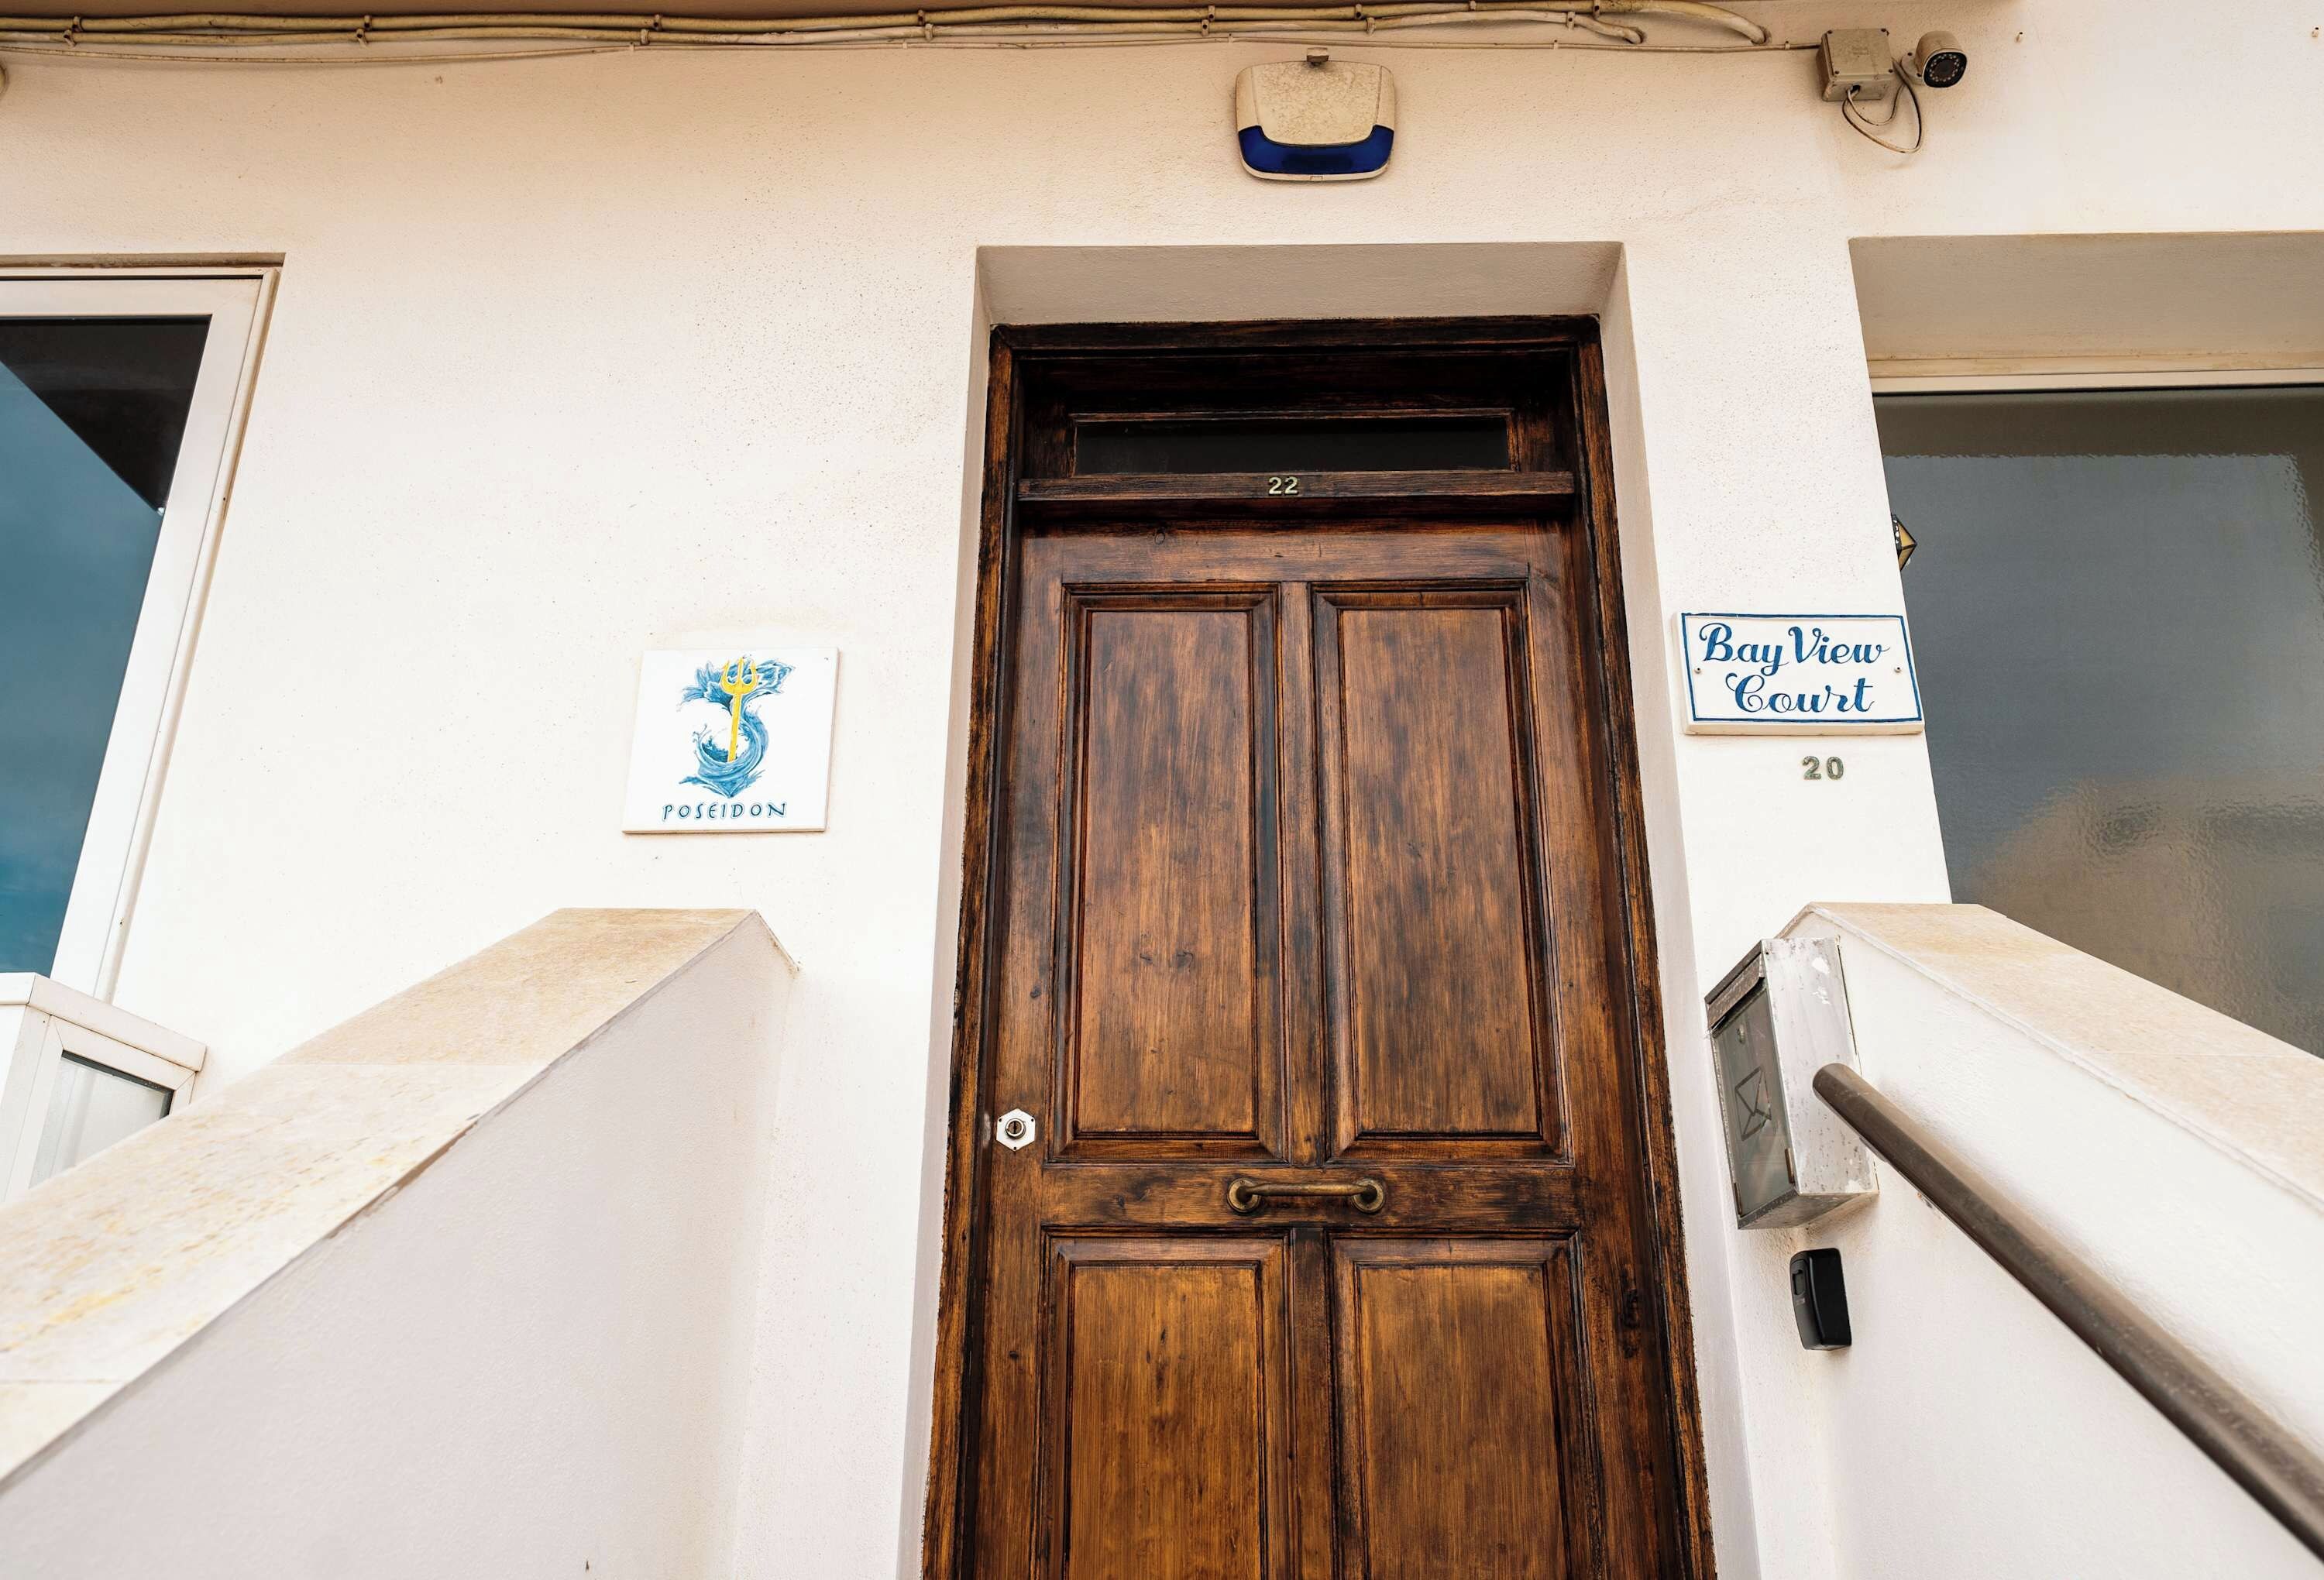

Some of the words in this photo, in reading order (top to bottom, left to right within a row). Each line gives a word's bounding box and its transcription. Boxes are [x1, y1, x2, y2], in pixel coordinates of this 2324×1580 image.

[1268, 476, 1298, 495] 22
[1699, 622, 1789, 677] Bay
[1787, 626, 1891, 665] View
[1725, 672, 1875, 713] Court
[1802, 755, 1844, 781] 20
[662, 801, 788, 821] POSEIDON
